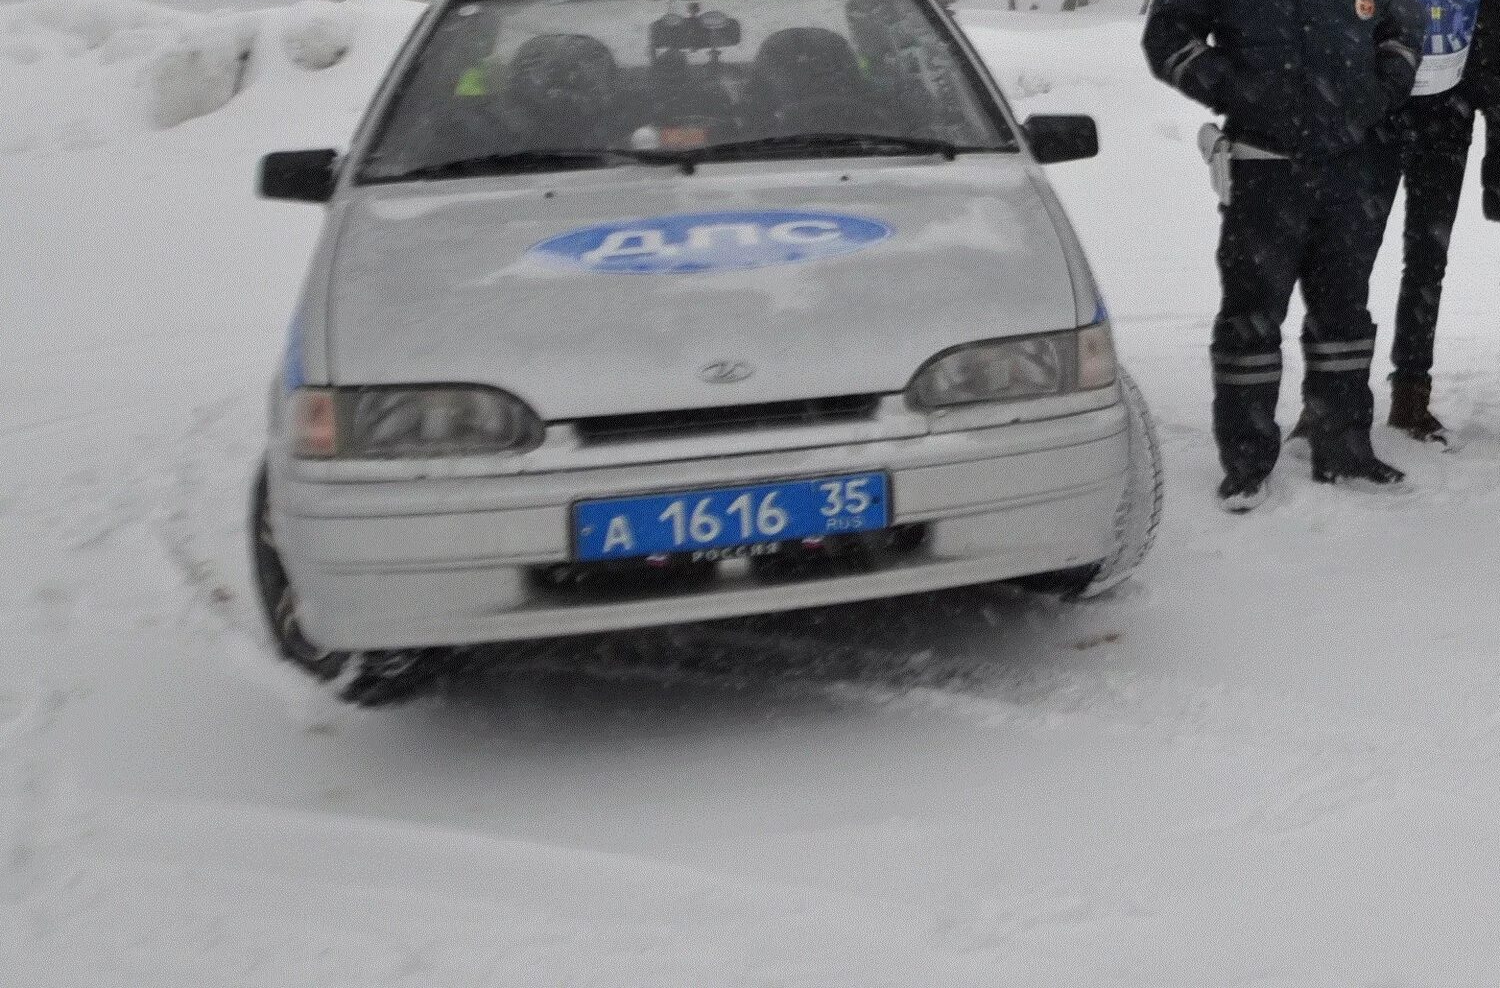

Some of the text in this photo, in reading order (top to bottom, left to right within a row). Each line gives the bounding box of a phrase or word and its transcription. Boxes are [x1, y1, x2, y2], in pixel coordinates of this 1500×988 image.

[582, 220, 843, 264] ДПС
[658, 490, 790, 546] 1616
[819, 478, 871, 517] 35
[825, 516, 864, 531] RUS
